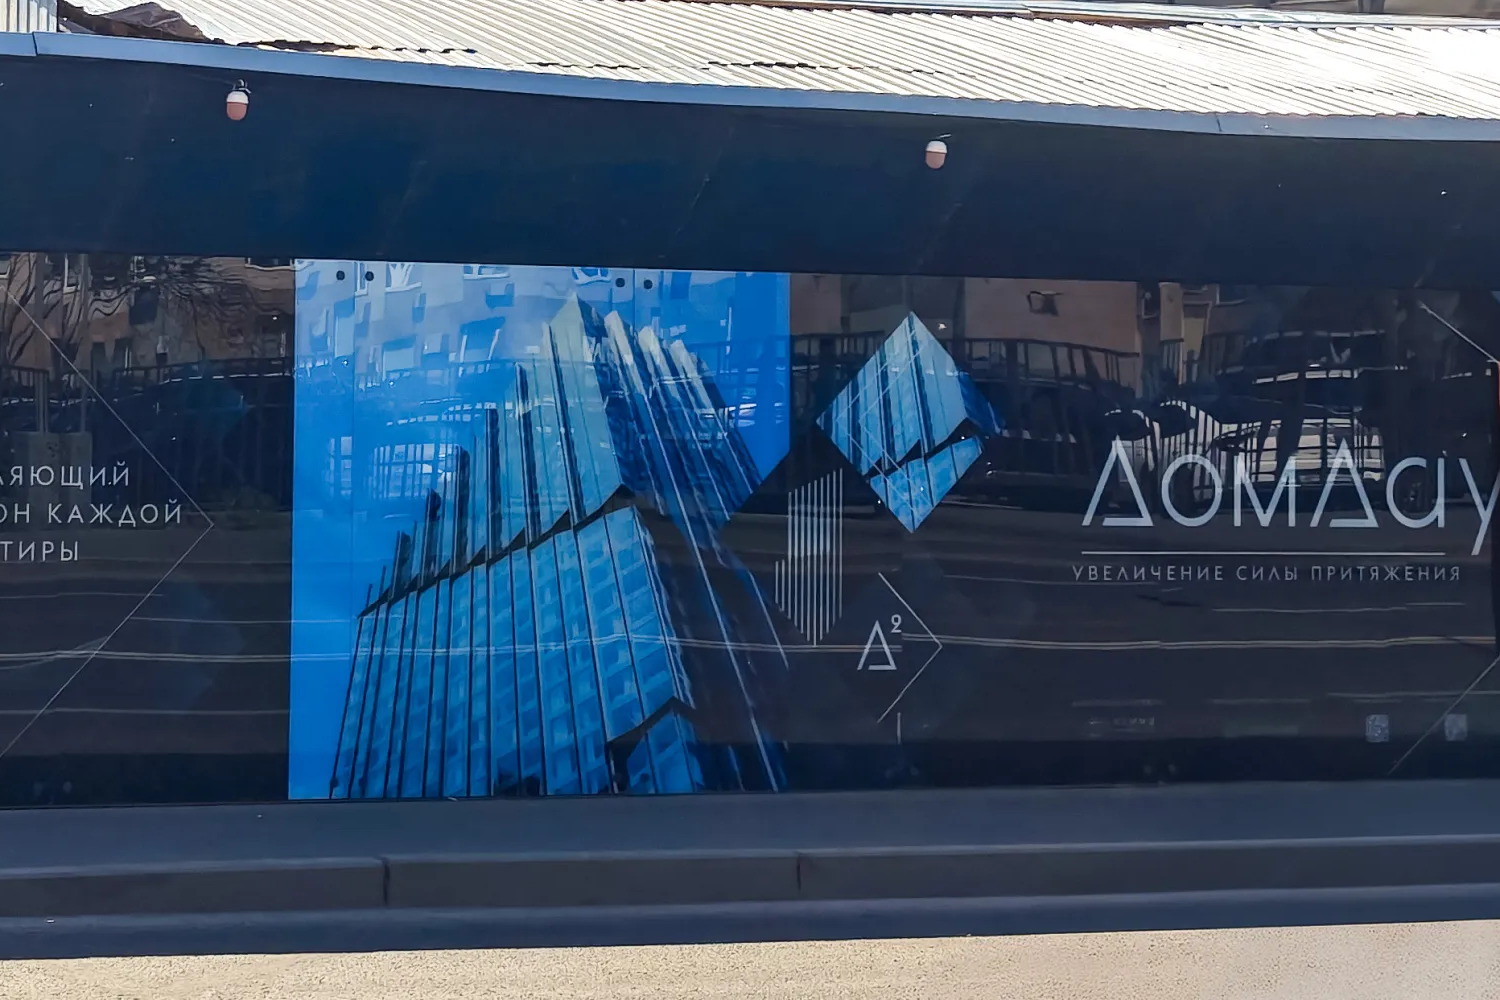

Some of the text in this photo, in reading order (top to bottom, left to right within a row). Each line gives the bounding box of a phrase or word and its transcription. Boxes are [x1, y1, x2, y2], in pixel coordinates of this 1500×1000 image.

[48, 498, 182, 527] КАЖДОЙ
[1072, 565, 1461, 582] УВЕЛИЧЕНИЕ СИЛЫ ПРИТЯЖЕНИЯ
